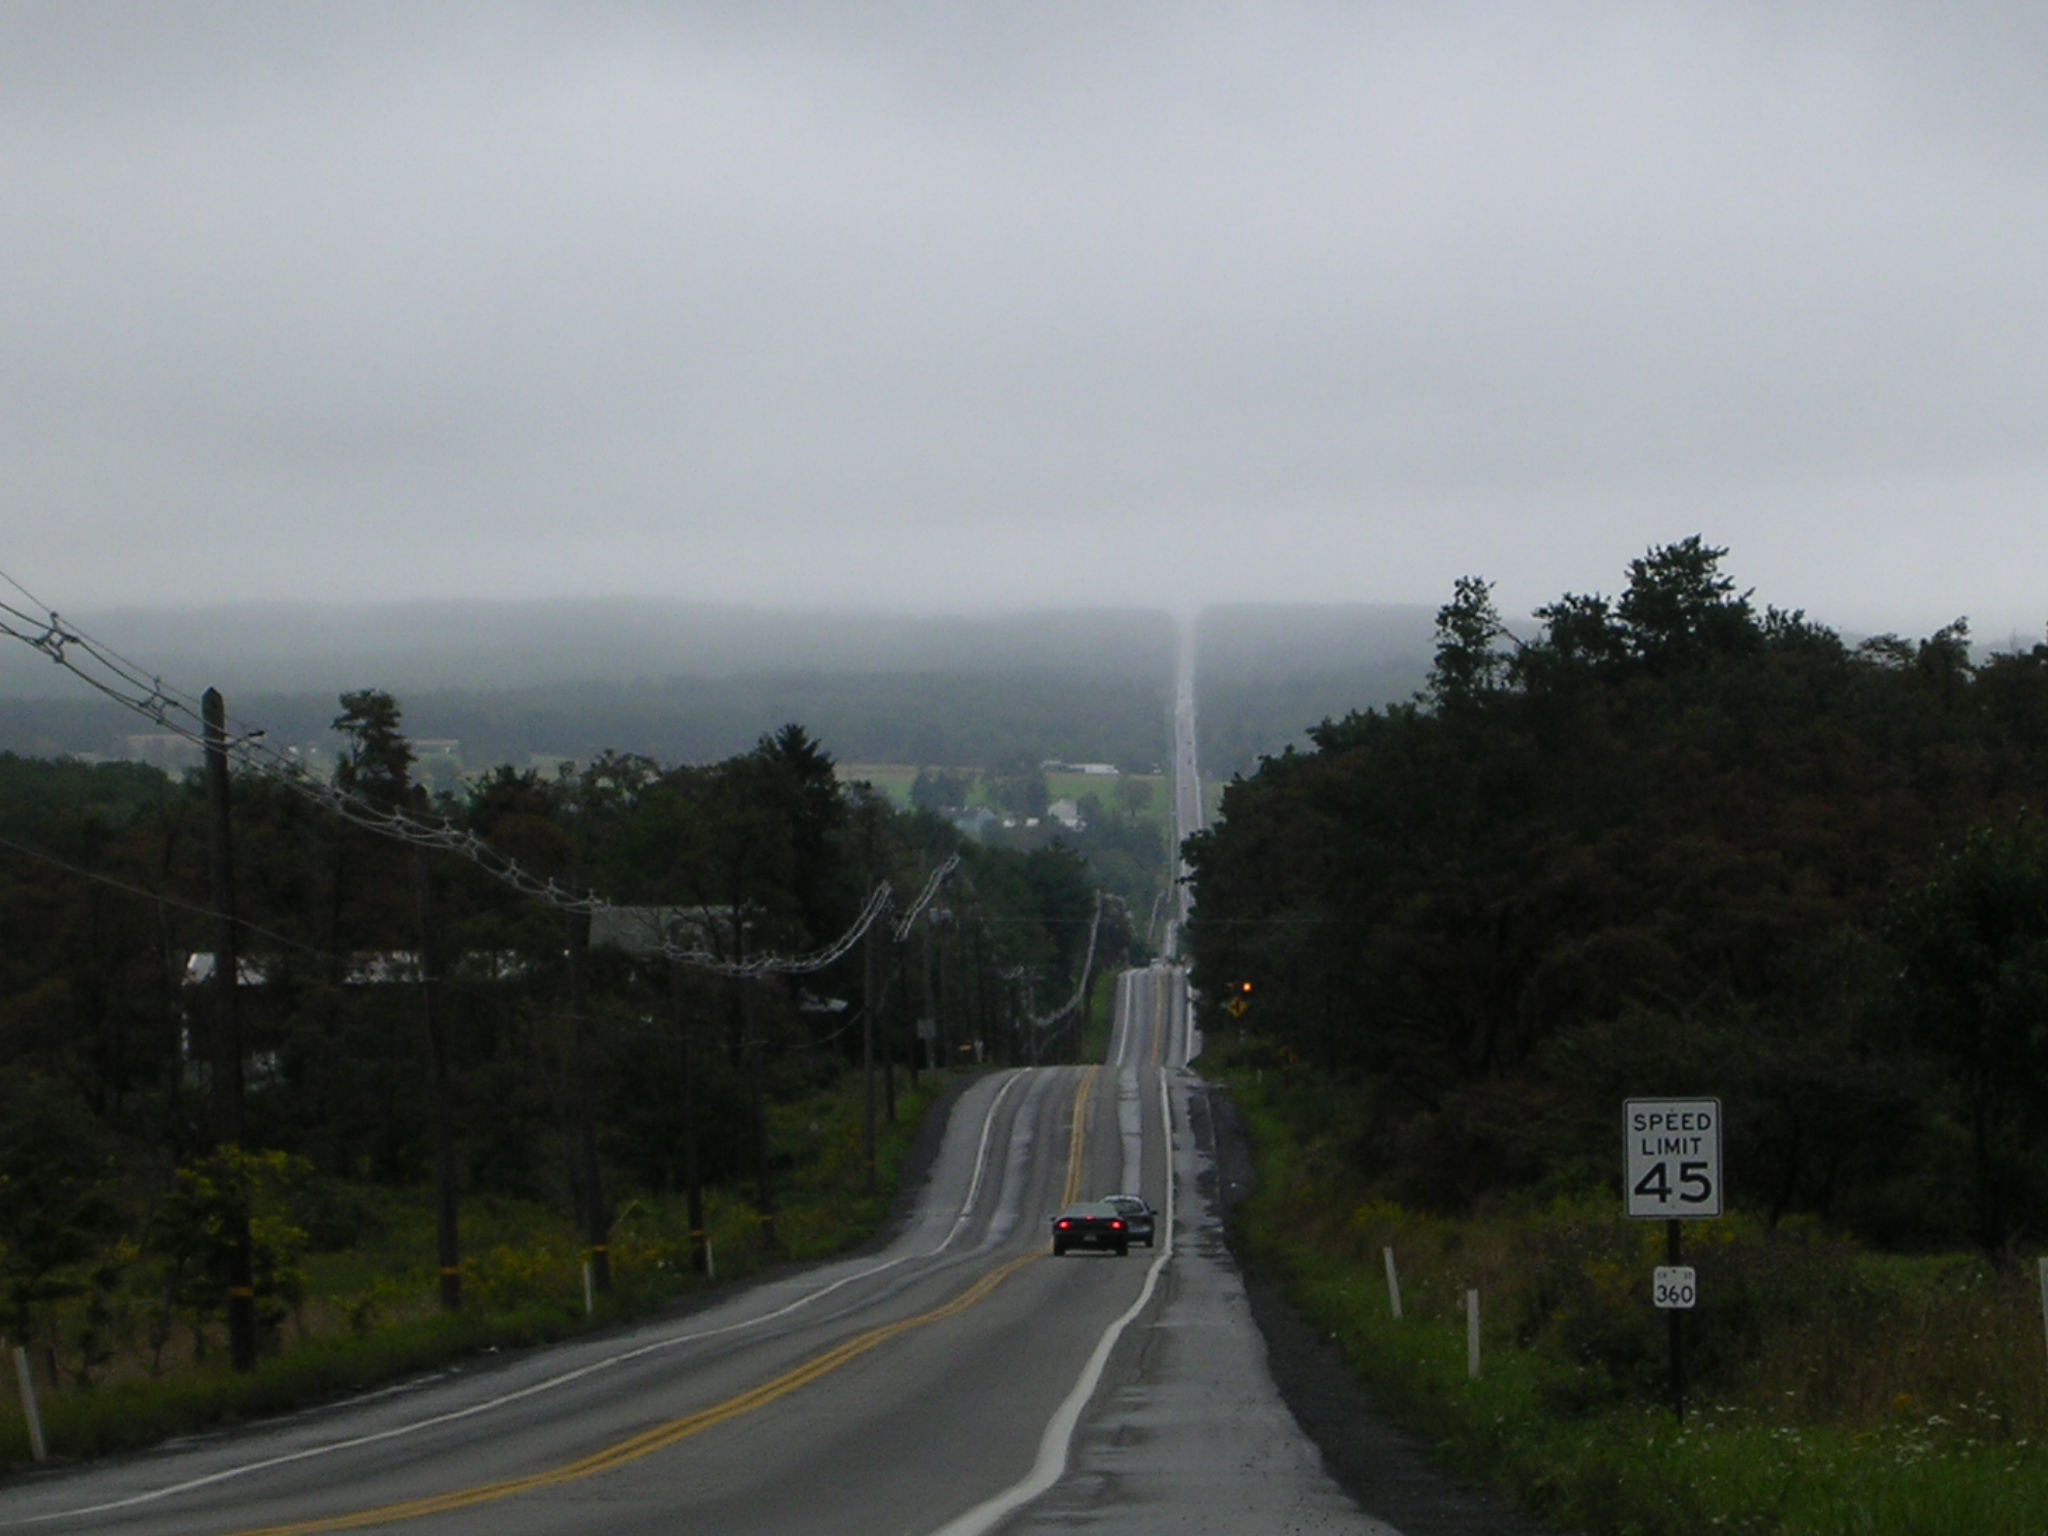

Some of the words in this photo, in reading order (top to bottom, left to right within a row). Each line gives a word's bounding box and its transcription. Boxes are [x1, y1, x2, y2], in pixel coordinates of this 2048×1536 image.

[1634, 1113, 1711, 1131] SPEED
[1642, 1138, 1702, 1155] LIMIT
[1634, 1162, 1712, 1203] 45
[1656, 1285, 1693, 1302] 360
